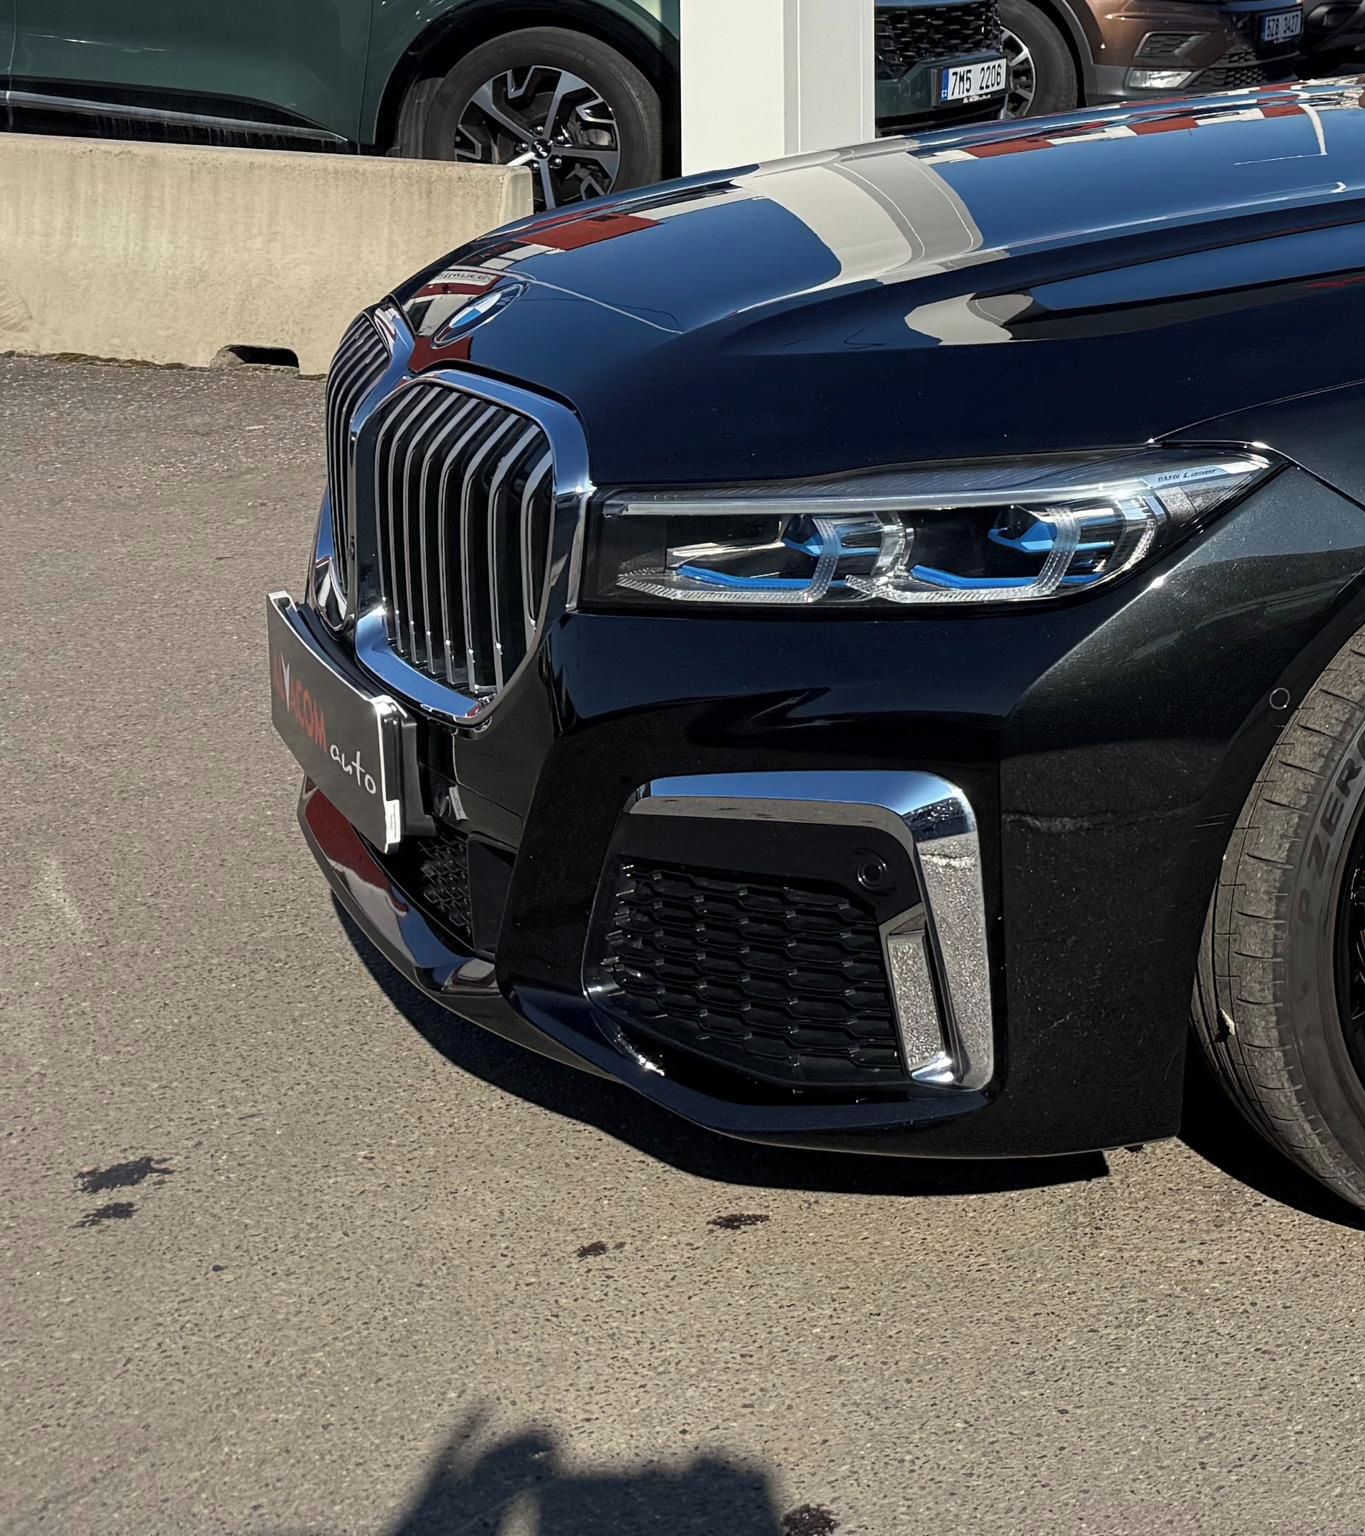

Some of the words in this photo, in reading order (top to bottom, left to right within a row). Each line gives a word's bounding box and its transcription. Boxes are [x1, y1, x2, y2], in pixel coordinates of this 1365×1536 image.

[951, 68, 973, 97] 7M5
[979, 63, 1002, 91] 2206
[329, 743, 377, 795] auto
